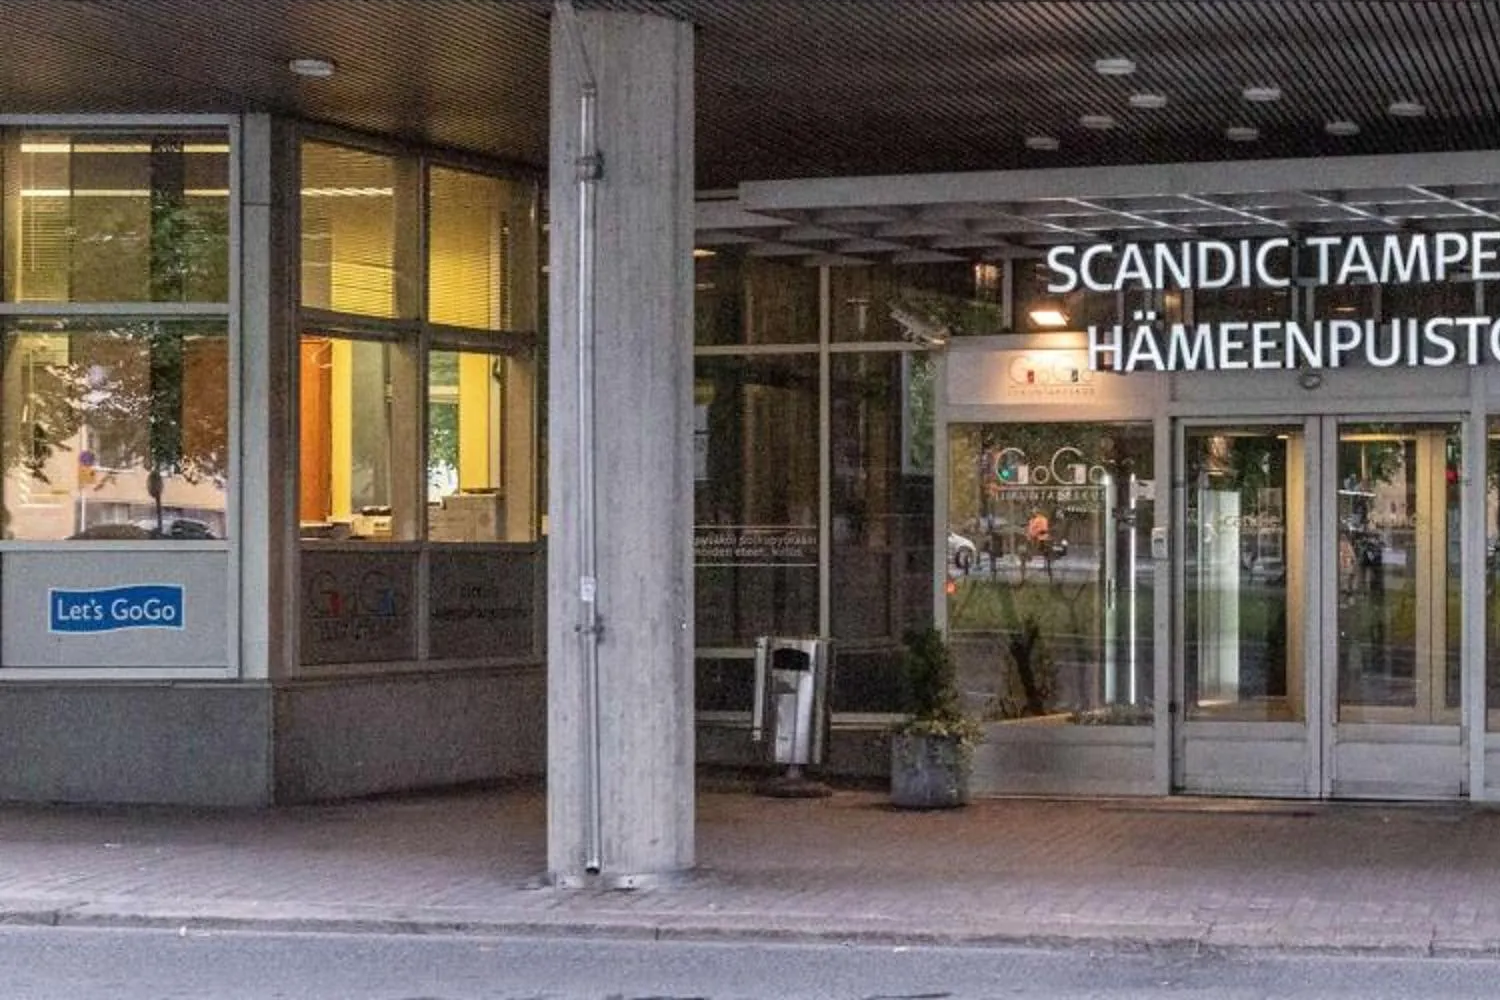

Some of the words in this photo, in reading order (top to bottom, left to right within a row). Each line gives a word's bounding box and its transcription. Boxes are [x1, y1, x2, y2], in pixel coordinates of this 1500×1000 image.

[1047, 238, 1291, 293] SCANDIC
[996, 447, 1110, 485] GoGo
[58, 598, 103, 621] Let's
[111, 598, 176, 621] GoGo
